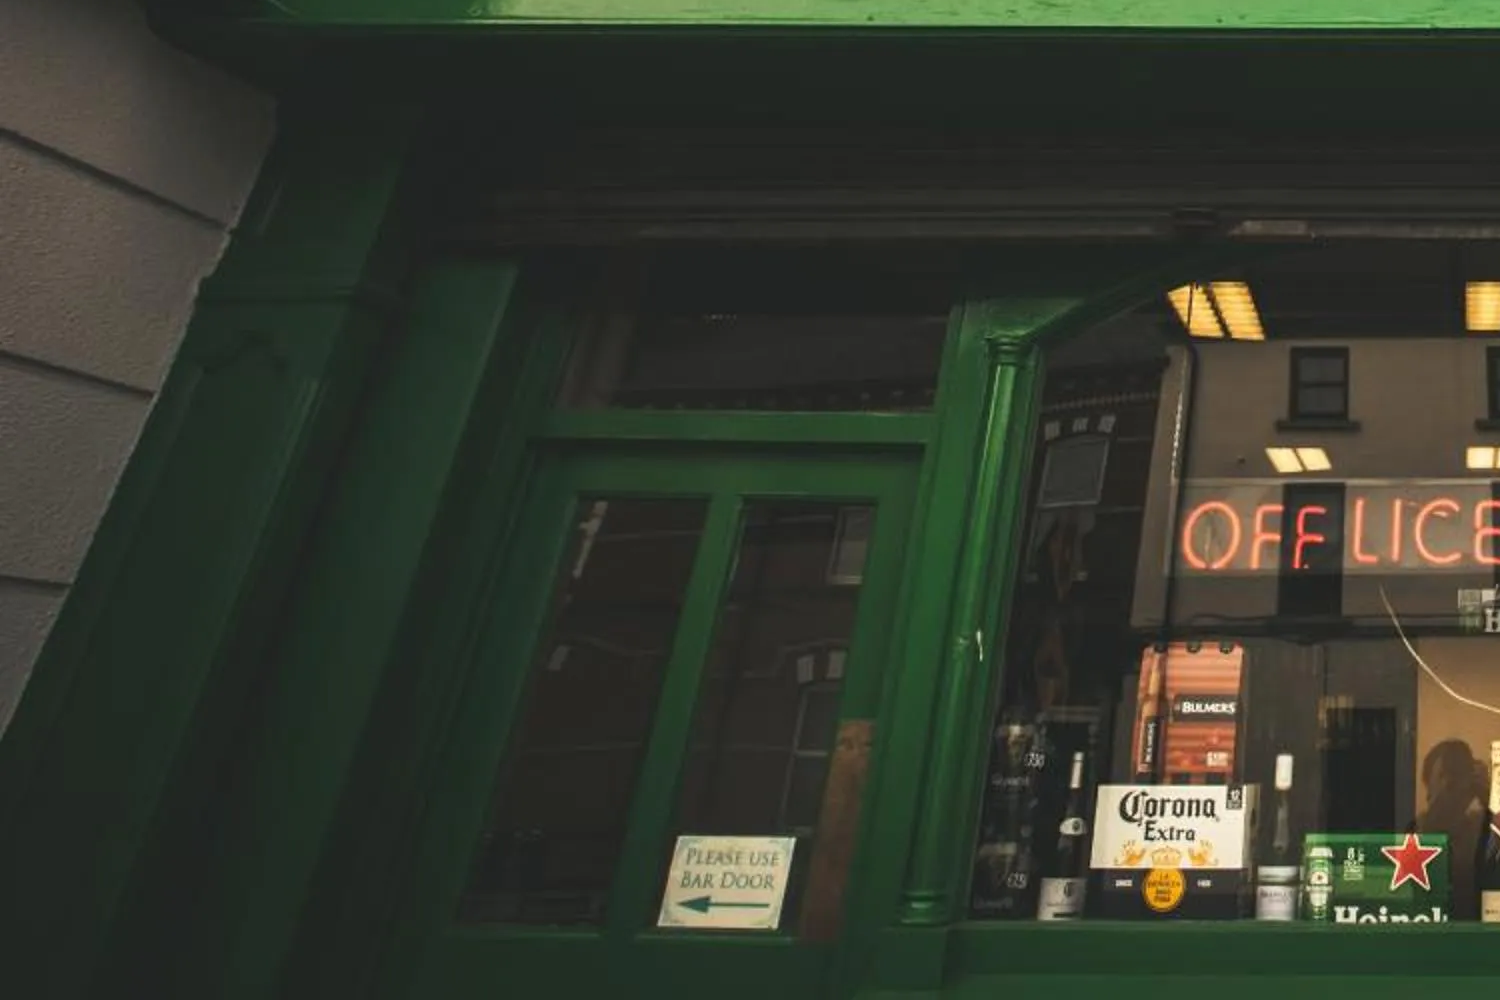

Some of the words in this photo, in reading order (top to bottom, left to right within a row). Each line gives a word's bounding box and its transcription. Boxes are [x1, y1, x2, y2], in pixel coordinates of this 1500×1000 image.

[1182, 500, 1327, 569] OFF
[1118, 789, 1217, 826] Corona
[1144, 820, 1197, 841] Extra
[686, 848, 743, 866] PLEASE
[750, 850, 781, 867] USE
[680, 871, 714, 889] BAR
[720, 871, 775, 890] DOOR
